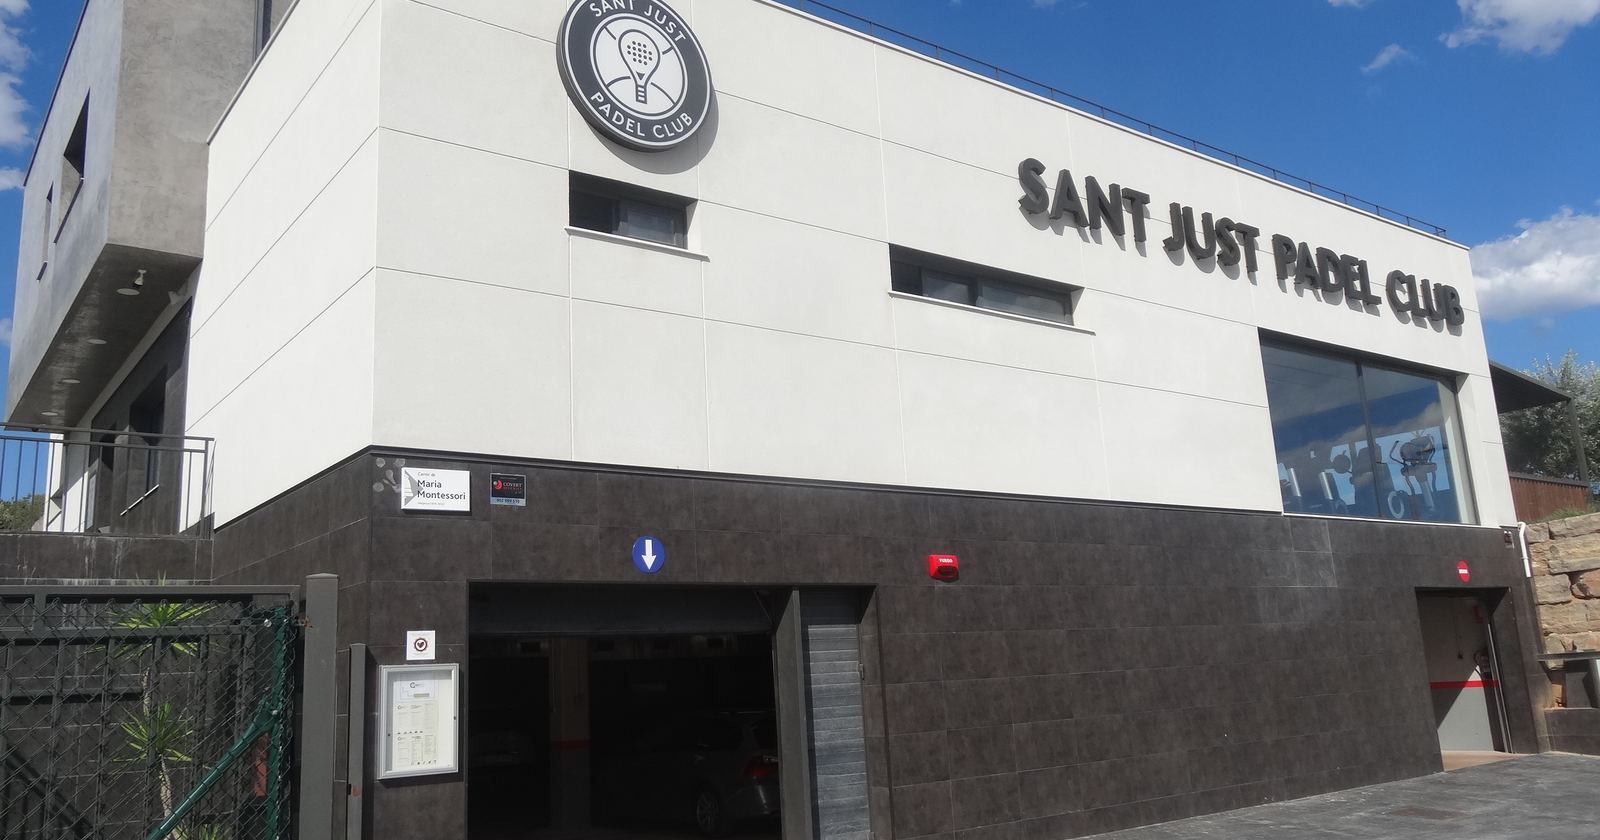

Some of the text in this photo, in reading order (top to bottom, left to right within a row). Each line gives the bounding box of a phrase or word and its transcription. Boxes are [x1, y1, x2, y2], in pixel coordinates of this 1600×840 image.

[644, 5, 687, 42] JUST
[590, 92, 693, 138] PADEL CLUB
[1018, 157, 1465, 326] SANT JUST PADEL CLUB
[417, 479, 442, 488] Maria
[417, 490, 466, 500] Montessori
